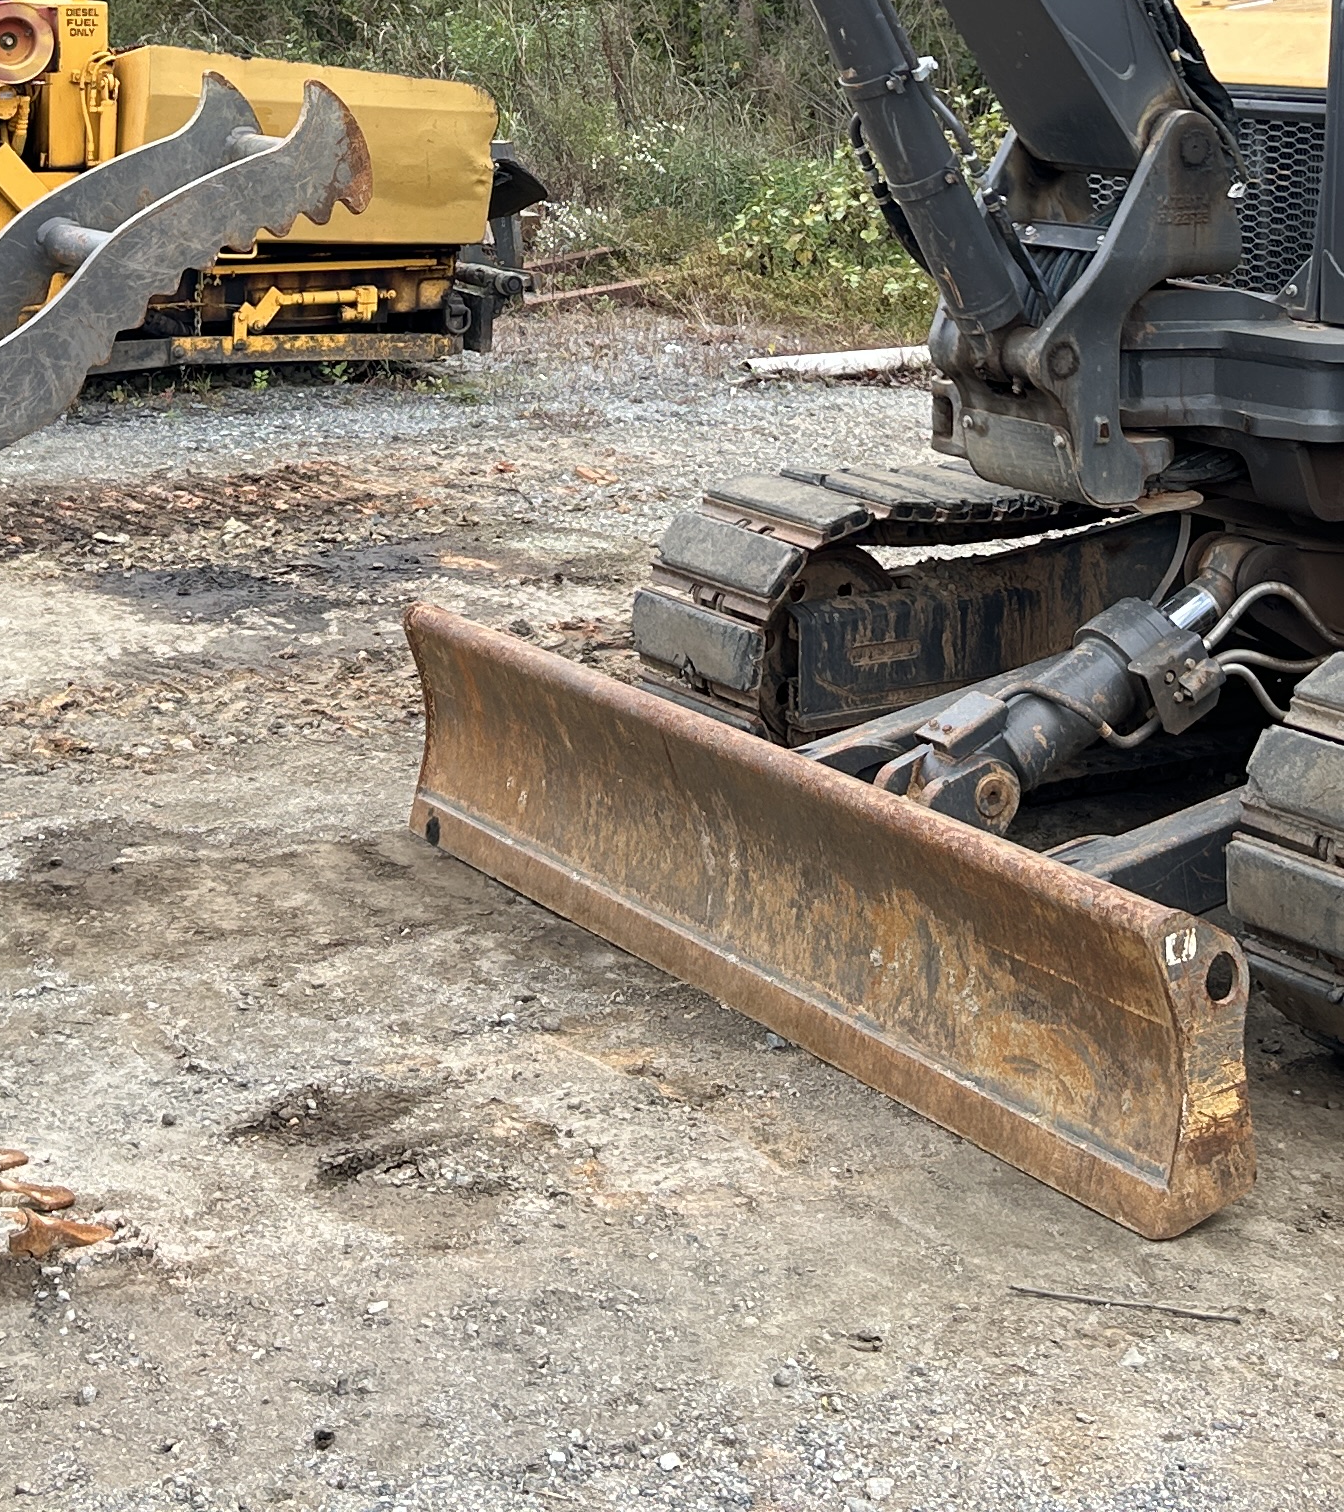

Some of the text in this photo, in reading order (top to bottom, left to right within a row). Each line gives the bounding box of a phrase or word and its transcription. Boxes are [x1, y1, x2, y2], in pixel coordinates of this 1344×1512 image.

[65, 7, 100, 17] DIESEL
[66, 18, 99, 27] FUEL
[69, 27, 96, 37] ONLY
